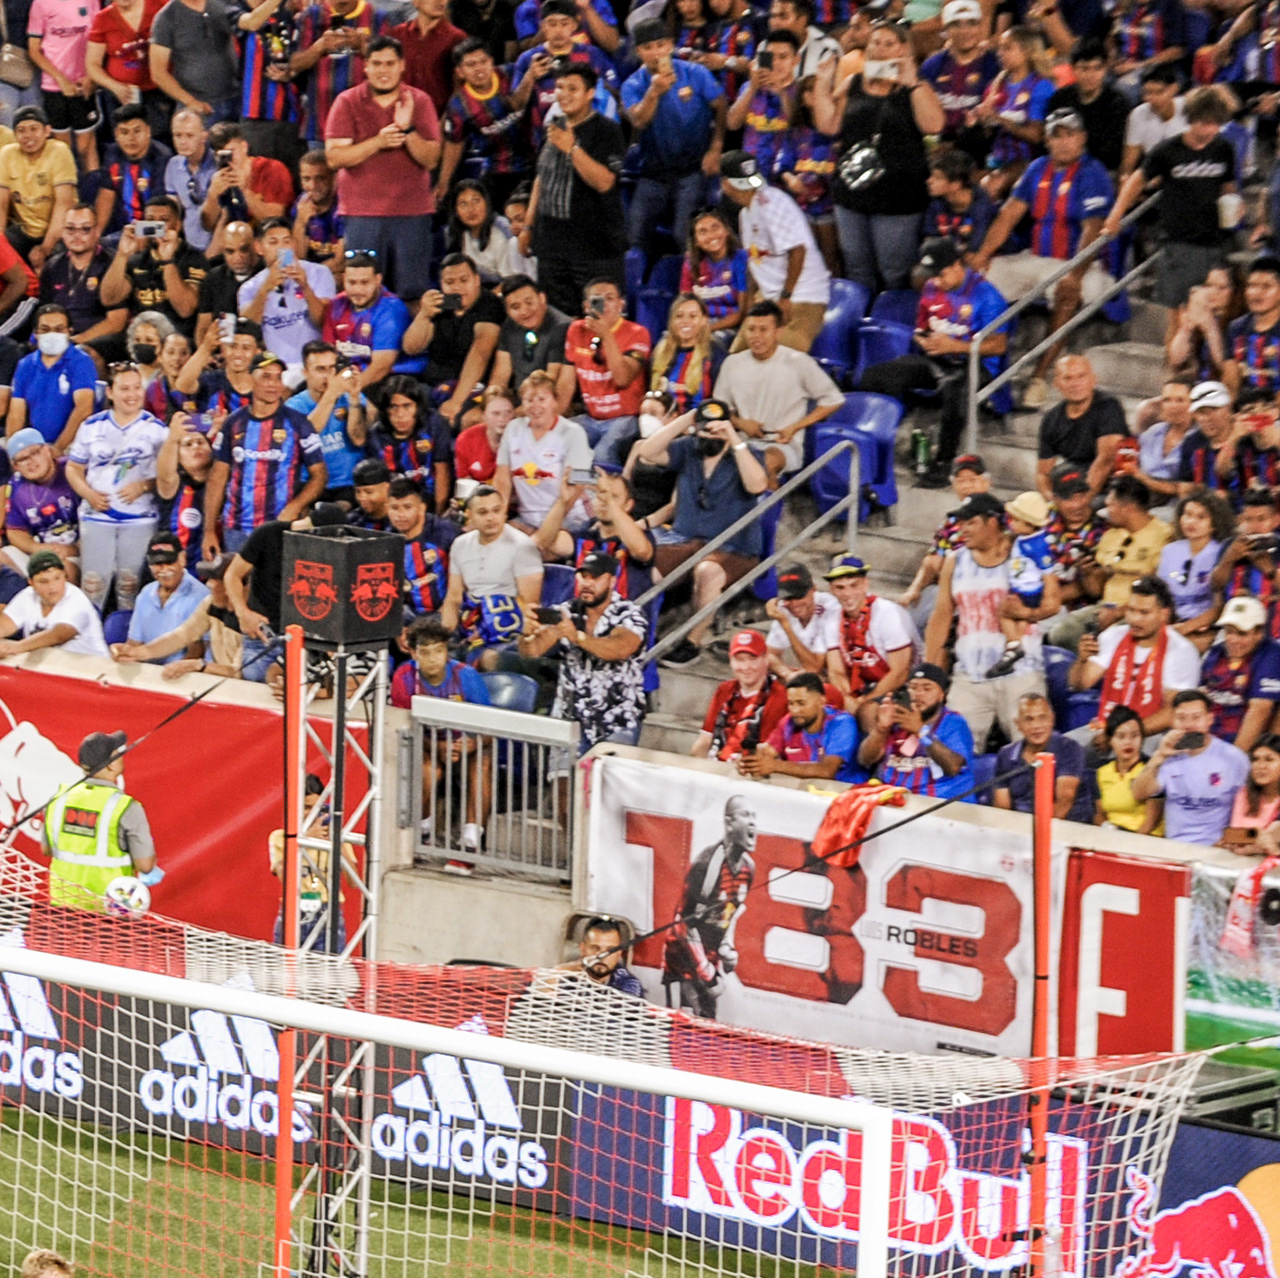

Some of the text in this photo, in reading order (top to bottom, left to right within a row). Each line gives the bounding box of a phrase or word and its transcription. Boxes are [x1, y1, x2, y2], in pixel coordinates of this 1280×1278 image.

[887, 926, 978, 958] ROBLES
[371, 1111, 548, 1188] adidas
[663, 1096, 862, 1241] Red
